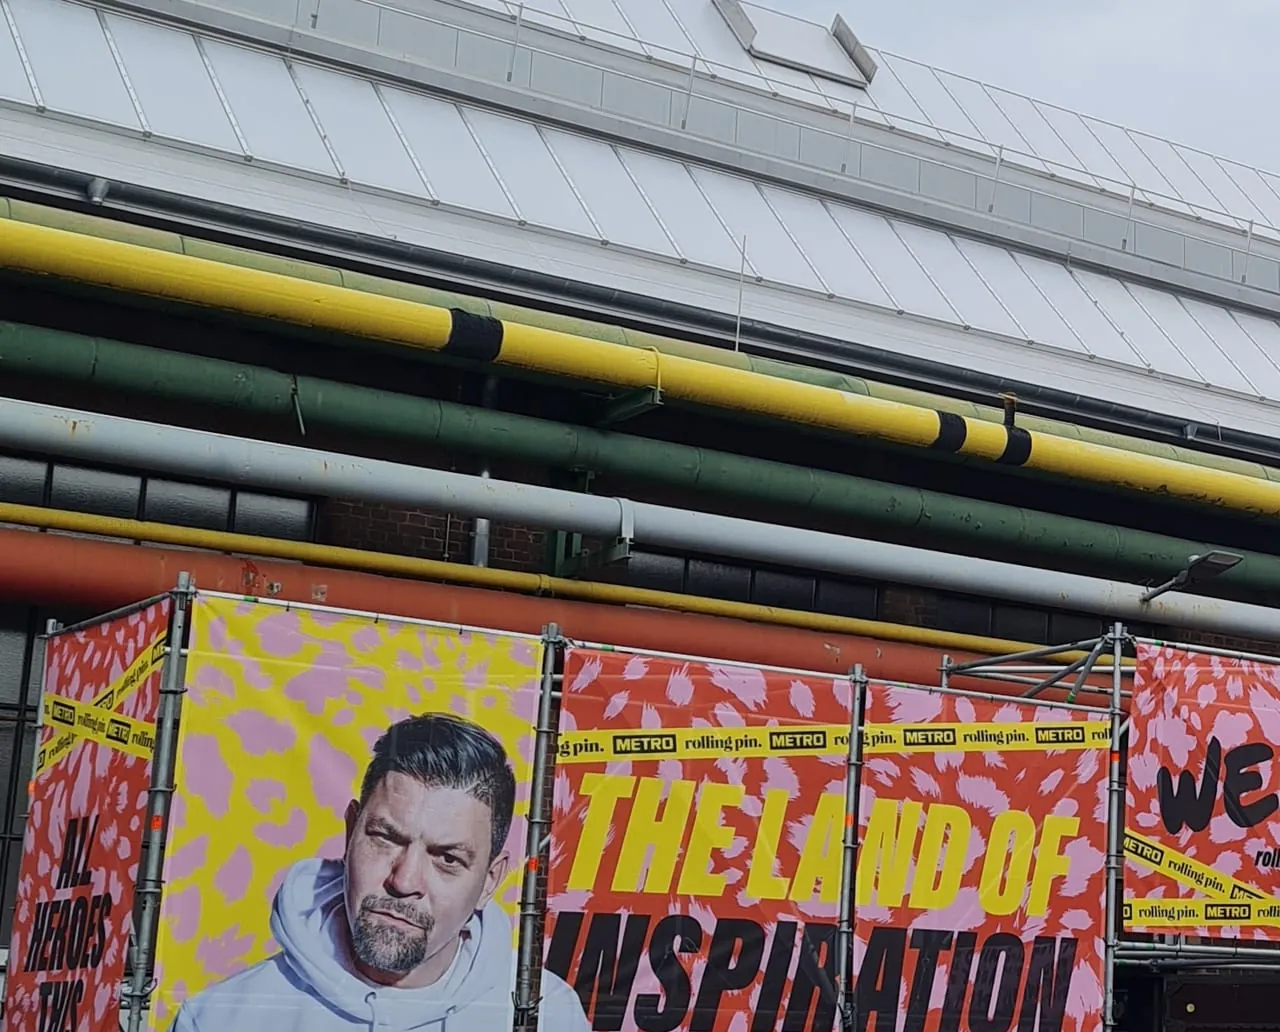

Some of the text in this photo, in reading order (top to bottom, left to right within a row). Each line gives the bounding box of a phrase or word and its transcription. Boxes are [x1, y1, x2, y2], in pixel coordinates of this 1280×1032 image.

[614, 735, 676, 753] METRO
[685, 735, 734, 751] rolling
[771, 733, 825, 748] METRO
[905, 730, 954, 744] METRO
[963, 729, 1004, 745] rolling
[1037, 728, 1083, 742] METRO
[1092, 728, 1112, 740] roll
[56, 814, 100, 890] ALL
[567, 773, 1081, 916] THE LAND OF
[1168, 860, 1204, 885] rolling
[1138, 906, 1176, 920] rolling
[1206, 905, 1250, 919] METRO
[24, 892, 112, 972] HEROES
